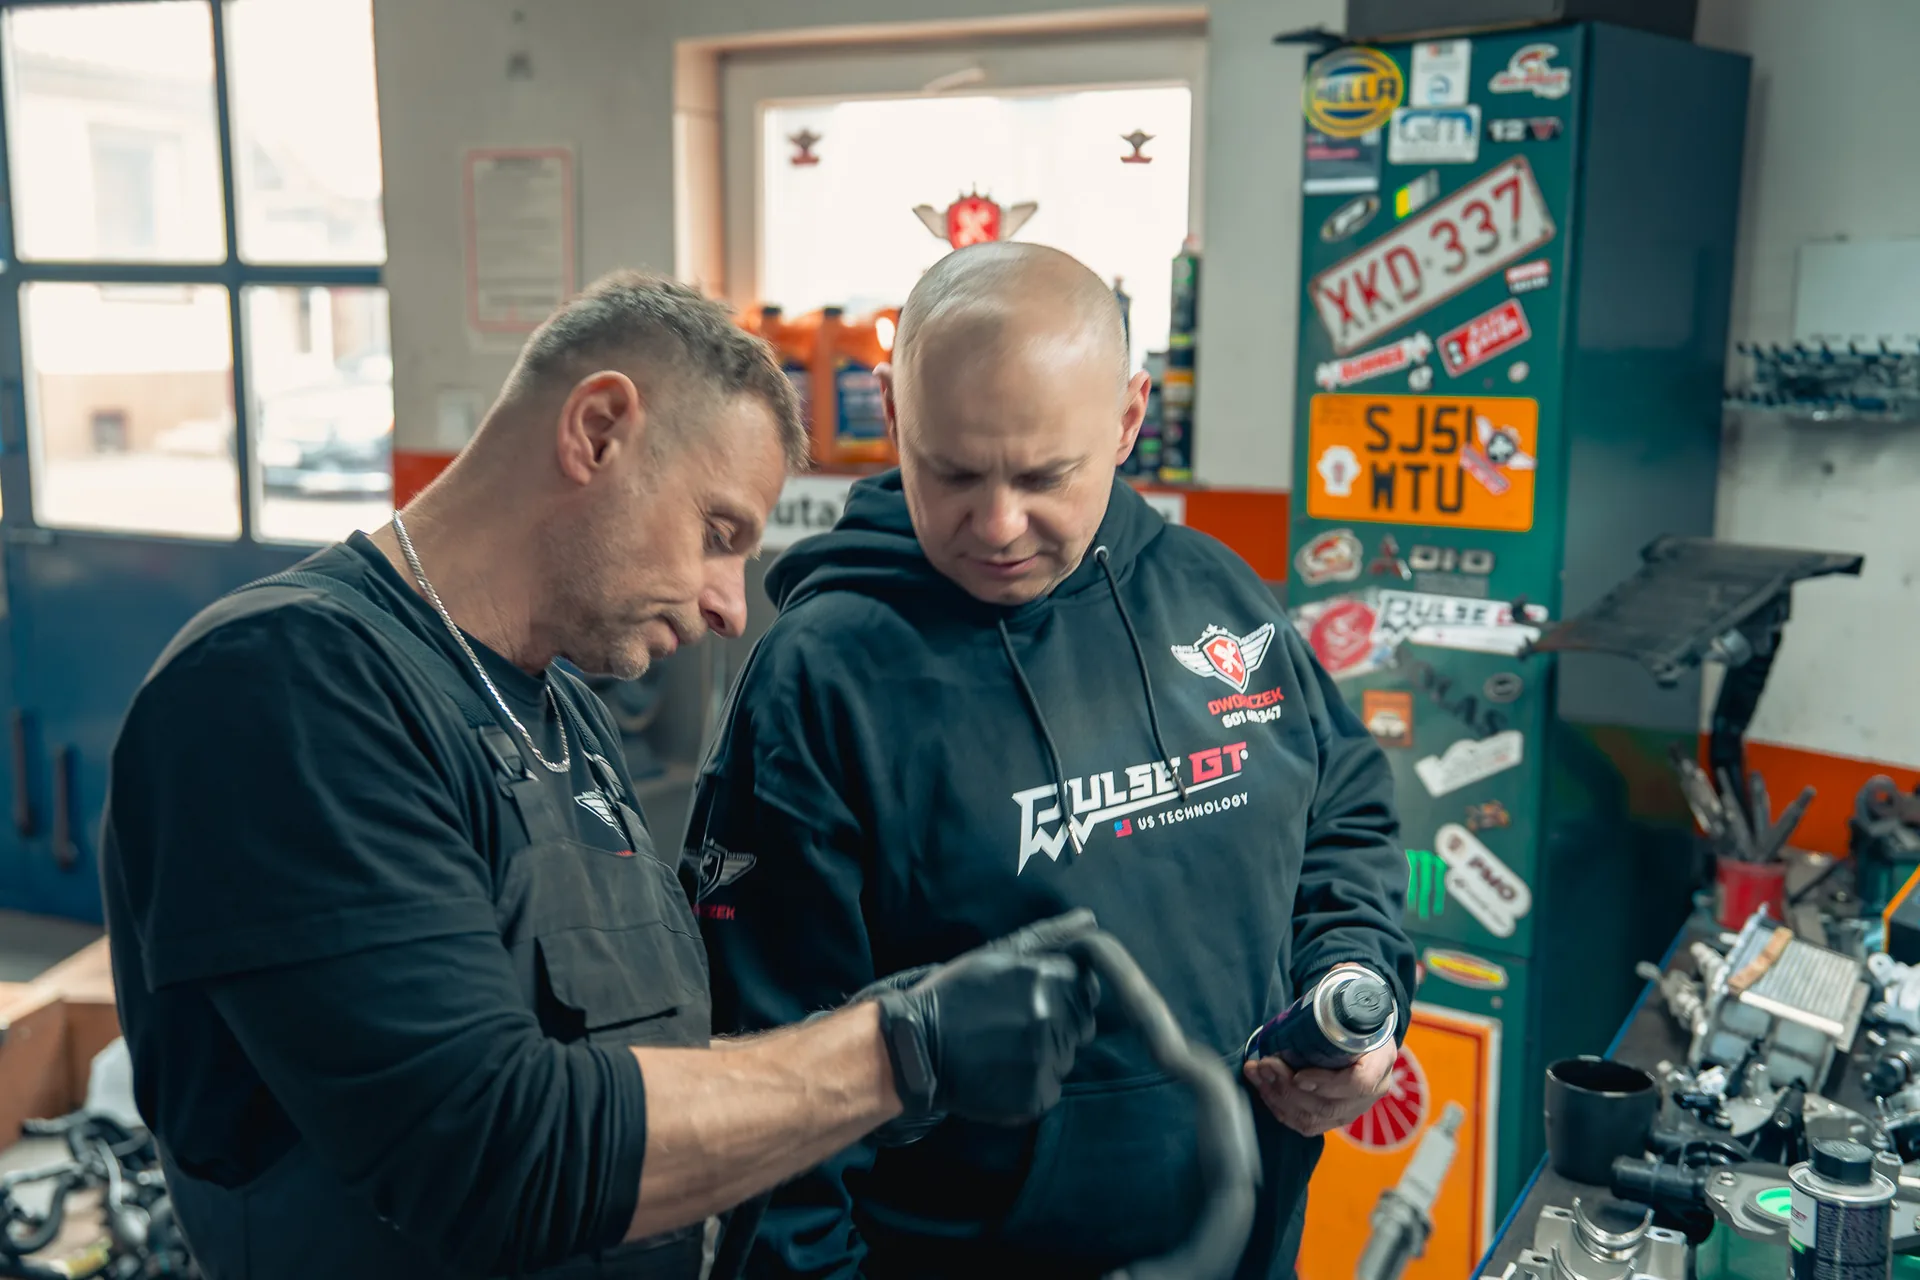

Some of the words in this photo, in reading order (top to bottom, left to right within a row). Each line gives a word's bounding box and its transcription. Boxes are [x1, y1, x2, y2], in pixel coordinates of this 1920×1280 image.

[1370, 462, 1465, 515] WTU
[1012, 756, 1181, 876] PULSE
[1137, 816, 1156, 831] US
[1158, 792, 1249, 826] TECHNOLOGY
